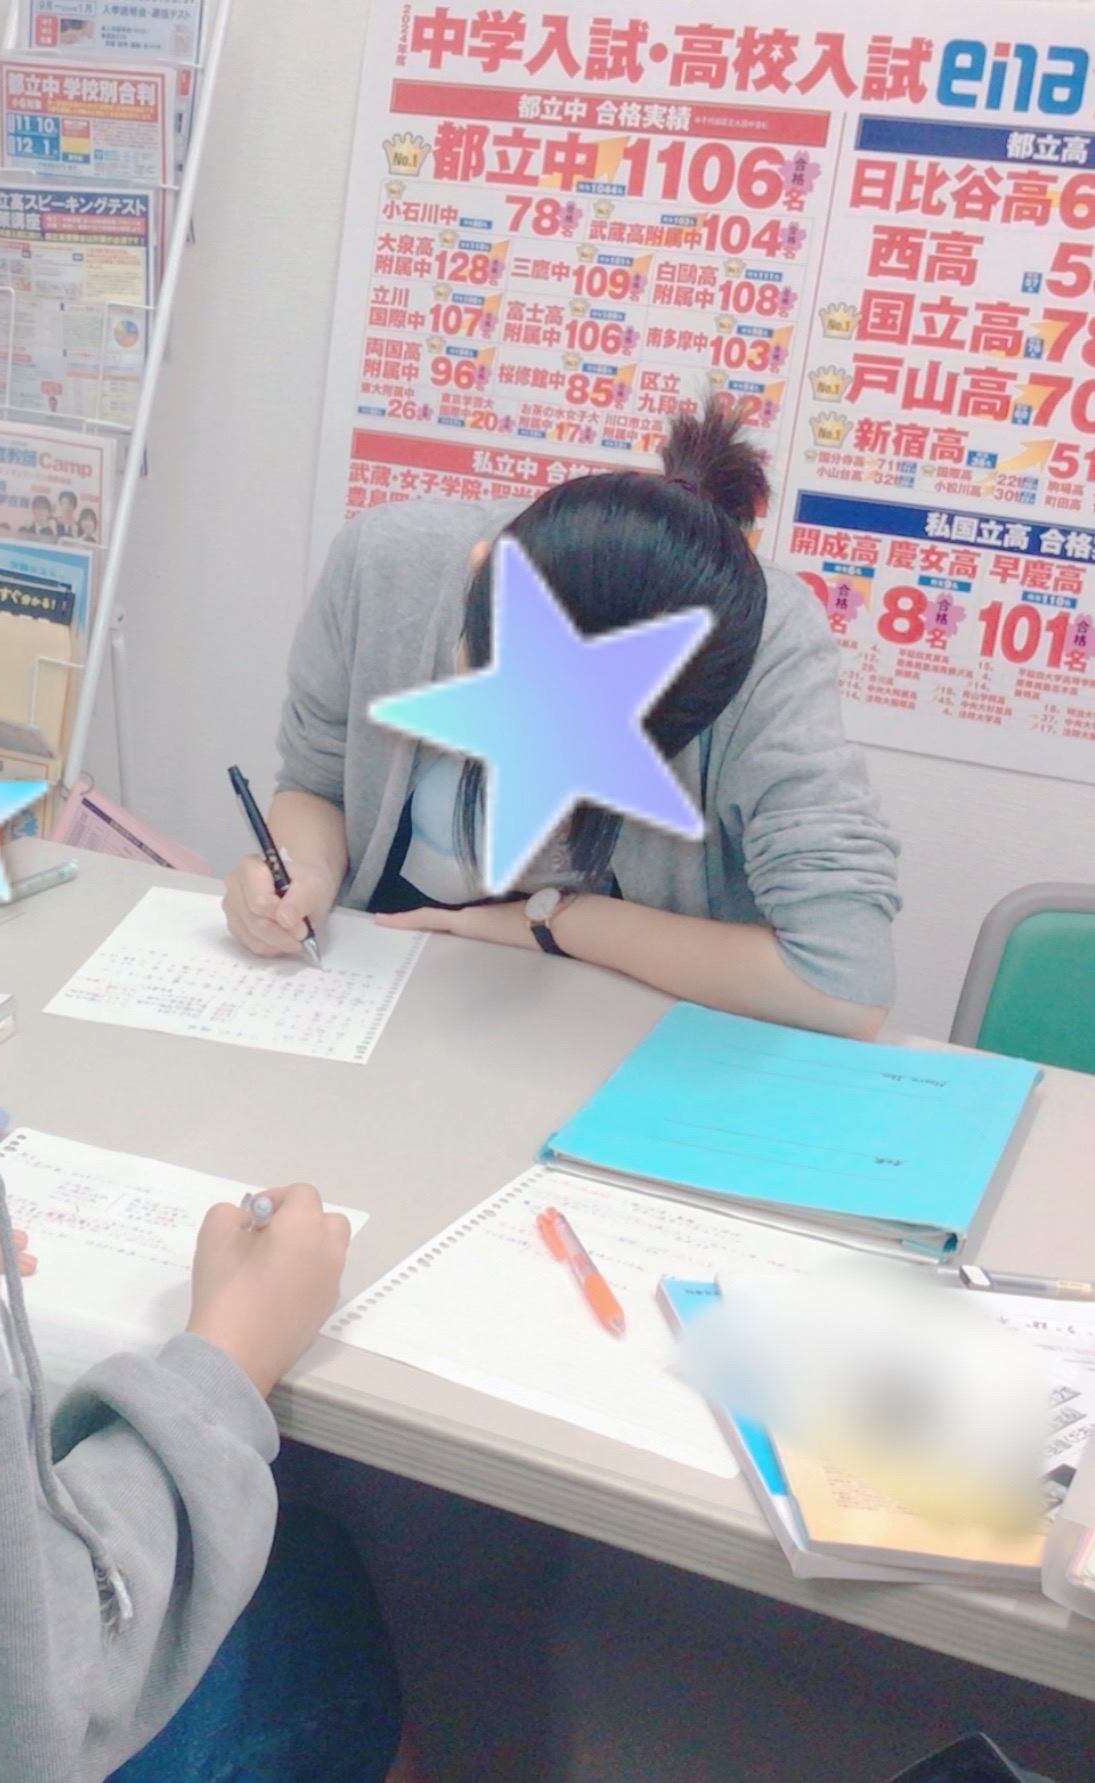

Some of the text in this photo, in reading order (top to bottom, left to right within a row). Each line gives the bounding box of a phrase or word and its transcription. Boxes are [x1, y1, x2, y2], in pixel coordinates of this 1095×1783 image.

[410, 7, 934, 105] 中学入試・高校入試
[517, 93, 587, 124] 都立中
[596, 101, 692, 133] 合格実績
[432, 120, 601, 193] 都立中
[1006, 131, 1091, 165] 都立高
[382, 200, 459, 226] 小石川中
[849, 158, 1059, 227] 日比谷高
[377, 233, 435, 257] 大泉高
[867, 224, 984, 287] 西高
[371, 285, 410, 307] 立川
[856, 289, 1030, 357] 国立高
[640, 371, 681, 394] 区立
[845, 353, 1017, 422] 戸山高
[472, 450, 539, 480] 私立中
[853, 418, 969, 466] 新宿高
[790, 526, 1087, 595] 開成高 慶女高 早慶高
[925, 511, 1095, 563] 私国立高 合格
